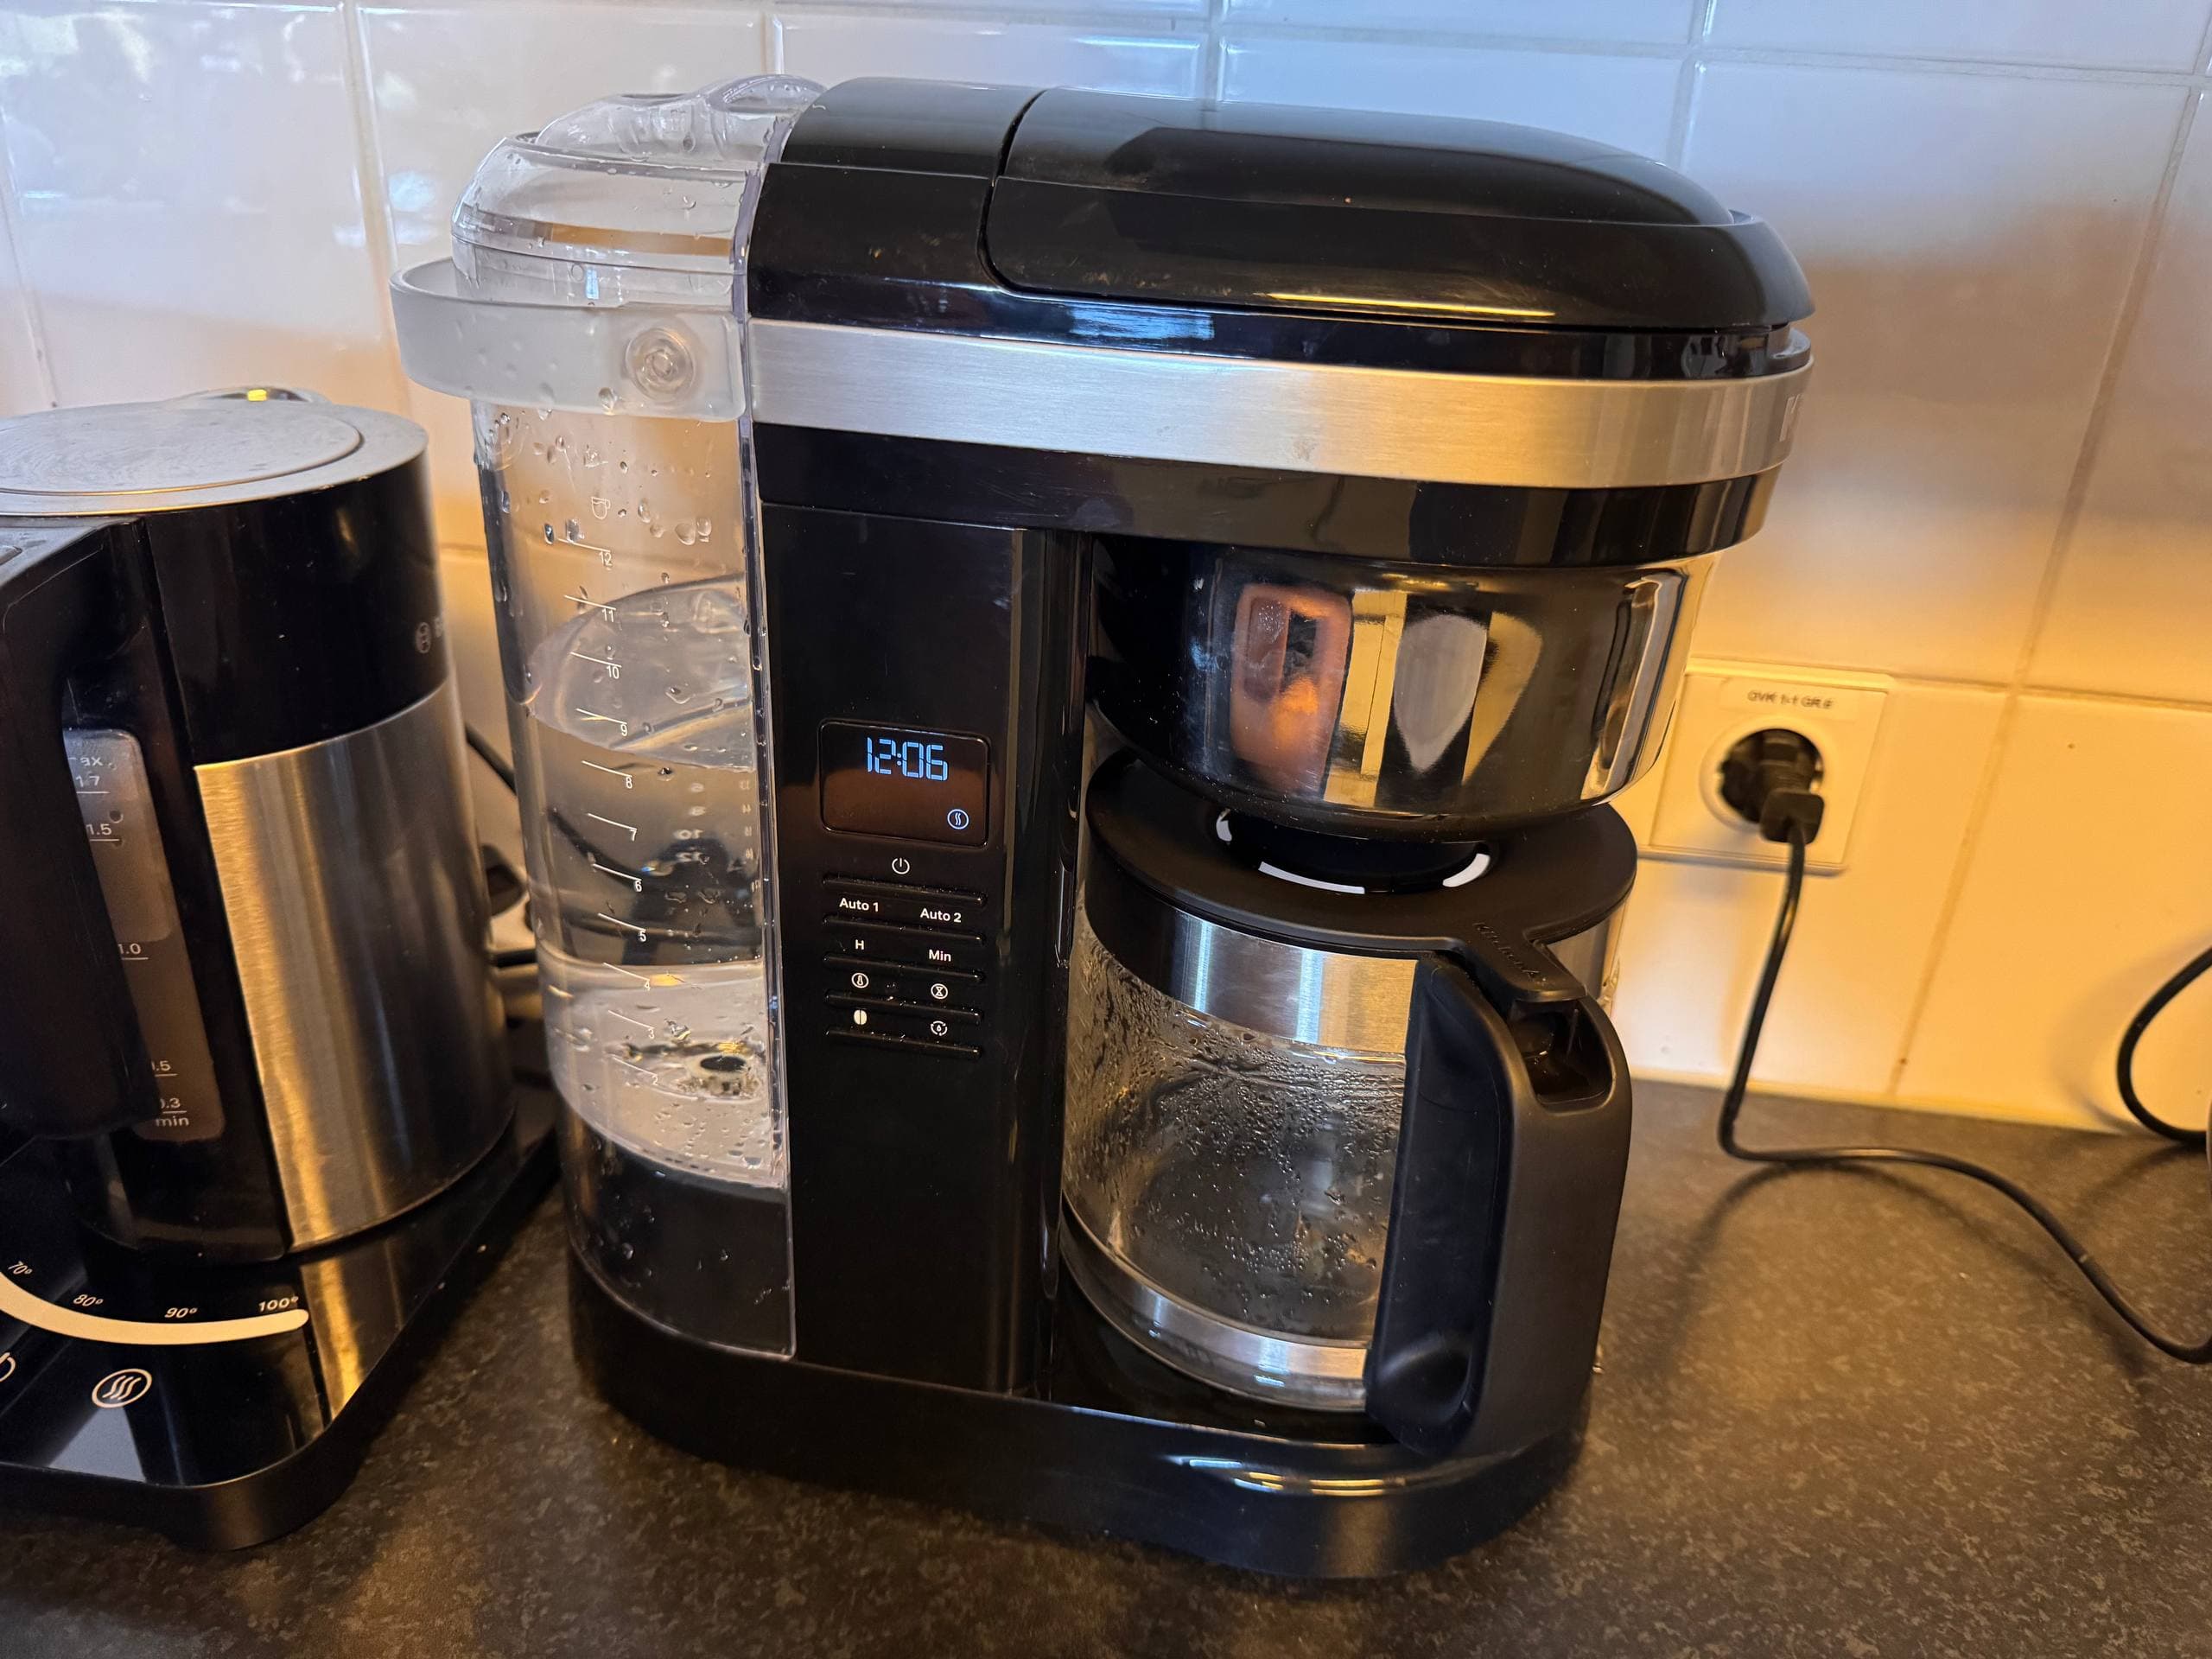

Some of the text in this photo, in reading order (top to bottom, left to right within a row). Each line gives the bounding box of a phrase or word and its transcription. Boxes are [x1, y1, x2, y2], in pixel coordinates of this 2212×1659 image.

[599, 551, 613, 566] 12
[602, 608, 615, 623] 11
[606, 665, 620, 679] 10
[620, 723, 628, 737] 9
[67, 756, 104, 767] ax
[866, 736, 949, 782] 12:06
[625, 776, 633, 790] 8
[85, 823, 112, 836] 1.5
[629, 829, 638, 842] 7
[633, 880, 643, 893] 6
[838, 897, 880, 912] Auto 1
[919, 907, 963, 924] Auto 2
[639, 930, 647, 943] 5
[118, 943, 142, 955] 1.0
[855, 939, 865, 950] H
[928, 948, 952, 963] Min
[644, 980, 651, 992] 4
[648, 1027, 655, 1039] 3
[156, 1115, 190, 1127] min
